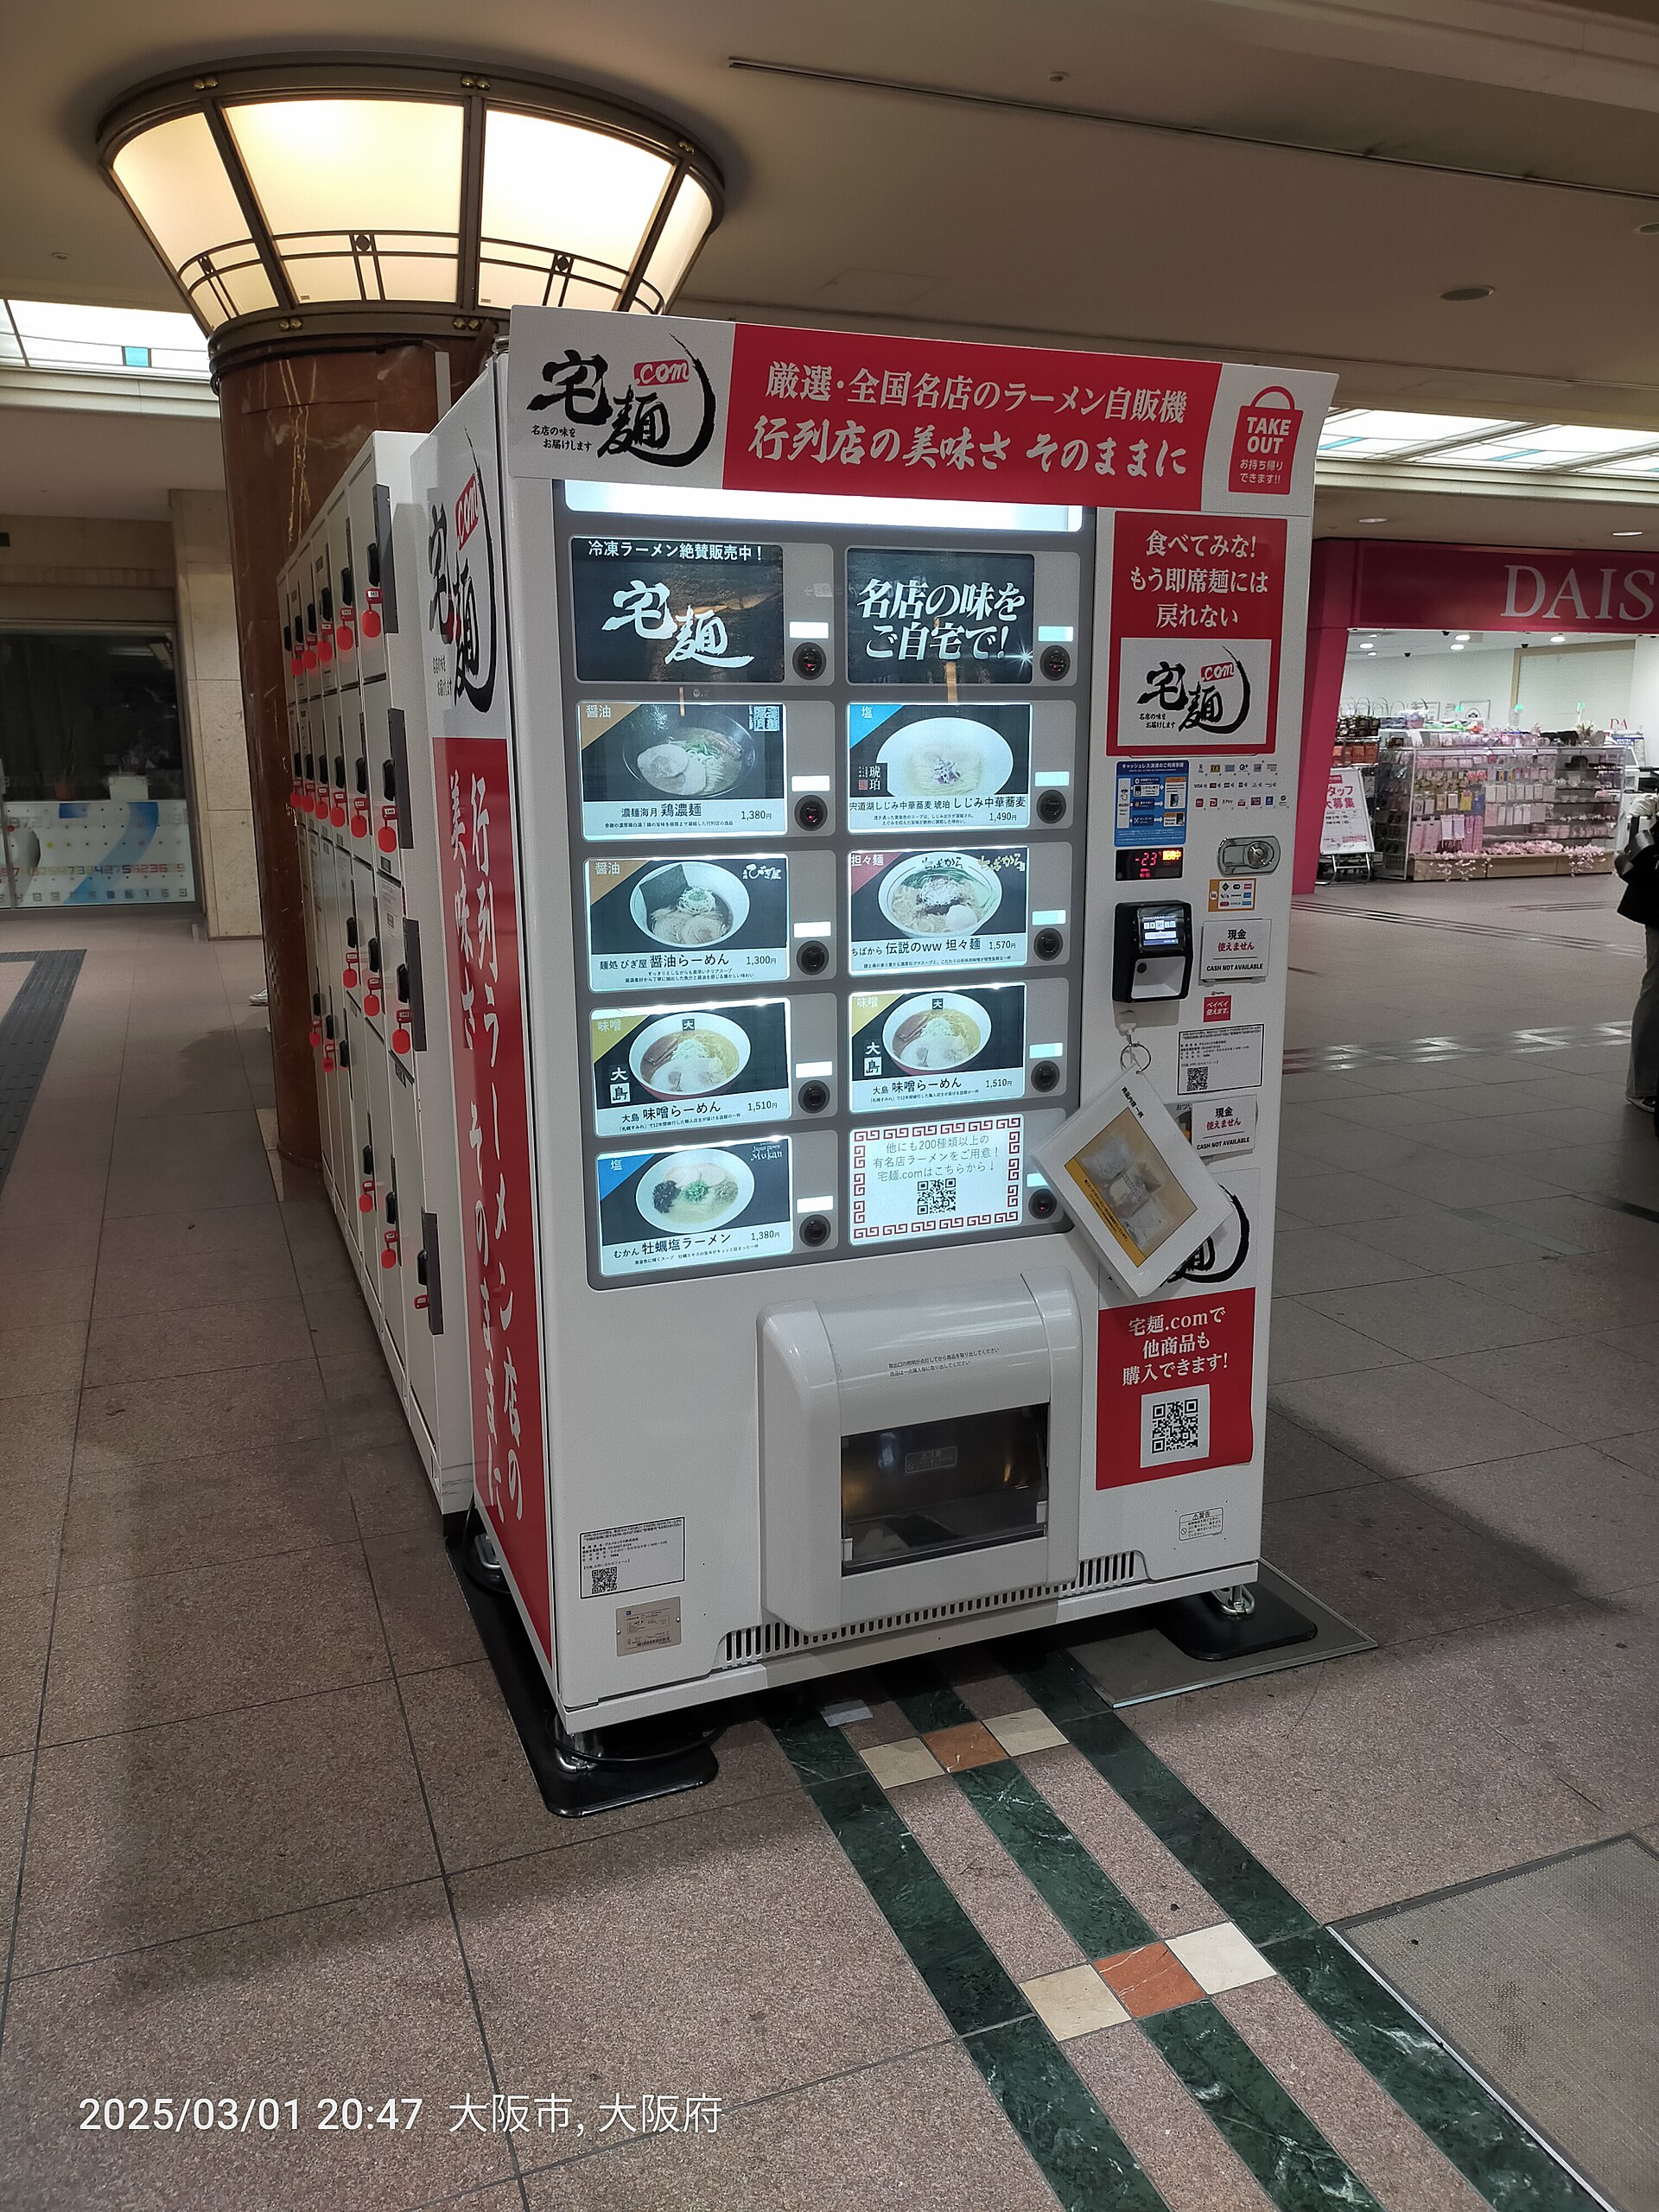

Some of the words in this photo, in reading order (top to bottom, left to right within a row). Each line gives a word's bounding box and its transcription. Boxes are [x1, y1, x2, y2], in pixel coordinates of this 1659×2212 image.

[766, 360, 1188, 423] 厳選・全国名店のラーメン自販機
[531, 424, 576, 438] 名店の味を
[1245, 416, 1292, 436] TAKE
[543, 438, 593, 453] お届けします
[748, 414, 1012, 472] 行列店の美味さ
[1026, 432, 1187, 478] そのままに
[1247, 435, 1286, 454] OUT
[1239, 459, 1284, 473] お持ち帰り
[588, 540, 763, 562] 冷凍ラーメン絶賛販売中！
[1145, 529, 1256, 558] 食べてみな!
[1130, 566, 1268, 594] もう即席麺には
[856, 578, 1026, 621] 名店の味を
[1501, 564, 1656, 620] DAIS
[1156, 602, 1238, 628] 戻れない
[601, 580, 755, 668] 宅麺
[866, 621, 1010, 661] ご自宅で!
[586, 705, 611, 718] 醤油
[861, 706, 873, 719] 塩
[868, 765, 881, 791] 琥珀
[1327, 786, 1353, 797] タッフ
[621, 806, 658, 818] 濃麺海月
[660, 803, 702, 817] 鶏濃麺
[849, 799, 931, 811] 宍道湖しじみ中華蕎麦
[934, 800, 950, 810] 琥珀
[953, 796, 1027, 810] しじみ中華蕎麦
[741, 810, 772, 821] 1,380円
[989, 811, 1017, 822] 1,490円
[595, 862, 620, 875] 醤油
[1228, 929, 1247, 940] 現金
[851, 946, 882, 957] ちばから
[886, 941, 942, 955] 伝説のww
[988, 939, 1016, 950] 1,570円
[1217, 942, 1255, 952] 使えません
[599, 960, 618, 970] 麺処
[620, 959, 647, 969] びぎ屋
[649, 953, 729, 969] 醤油らーめん
[746, 955, 777, 965] 1,300円
[856, 996, 878, 1007] 味噌
[932, 999, 944, 1009] 大
[597, 1020, 621, 1032] 味噌
[682, 1019, 694, 1030] 大
[865, 1041, 881, 1074] 大島
[611, 1067, 629, 1102] 大島
[873, 1086, 889, 1096] 大島
[892, 1077, 962, 1093] 味噌らーめん
[986, 1078, 1013, 1088] 1,510円
[621, 1113, 639, 1123] 大島
[642, 1102, 721, 1121] 味噌らーめん
[747, 1101, 778, 1111] 1,510円
[1215, 1106, 1233, 1118] 現金
[1206, 1117, 1241, 1130] 使えません
[472, 772, 522, 1522] 行列ラーメン店の
[886, 1135, 989, 1154] 他にも200種類以上の
[1197, 1142, 1211, 1151] CASH
[1222, 1136, 1250, 1146] AVAILABLE
[750, 1150, 783, 1161] Mukan
[873, 1147, 999, 1169] 有名店ラーメンをご用意！
[610, 1159, 623, 1172] 塩
[751, 1230, 780, 1241] 1,380円
[613, 1248, 639, 1259] むかん
[641, 1234, 731, 1255] 牡蠣塩ラーメン
[1128, 1306, 1226, 1338] 宅麺.comで
[1141, 1332, 1211, 1360] 他商品も
[1122, 1351, 1229, 1387] 購入できます!
